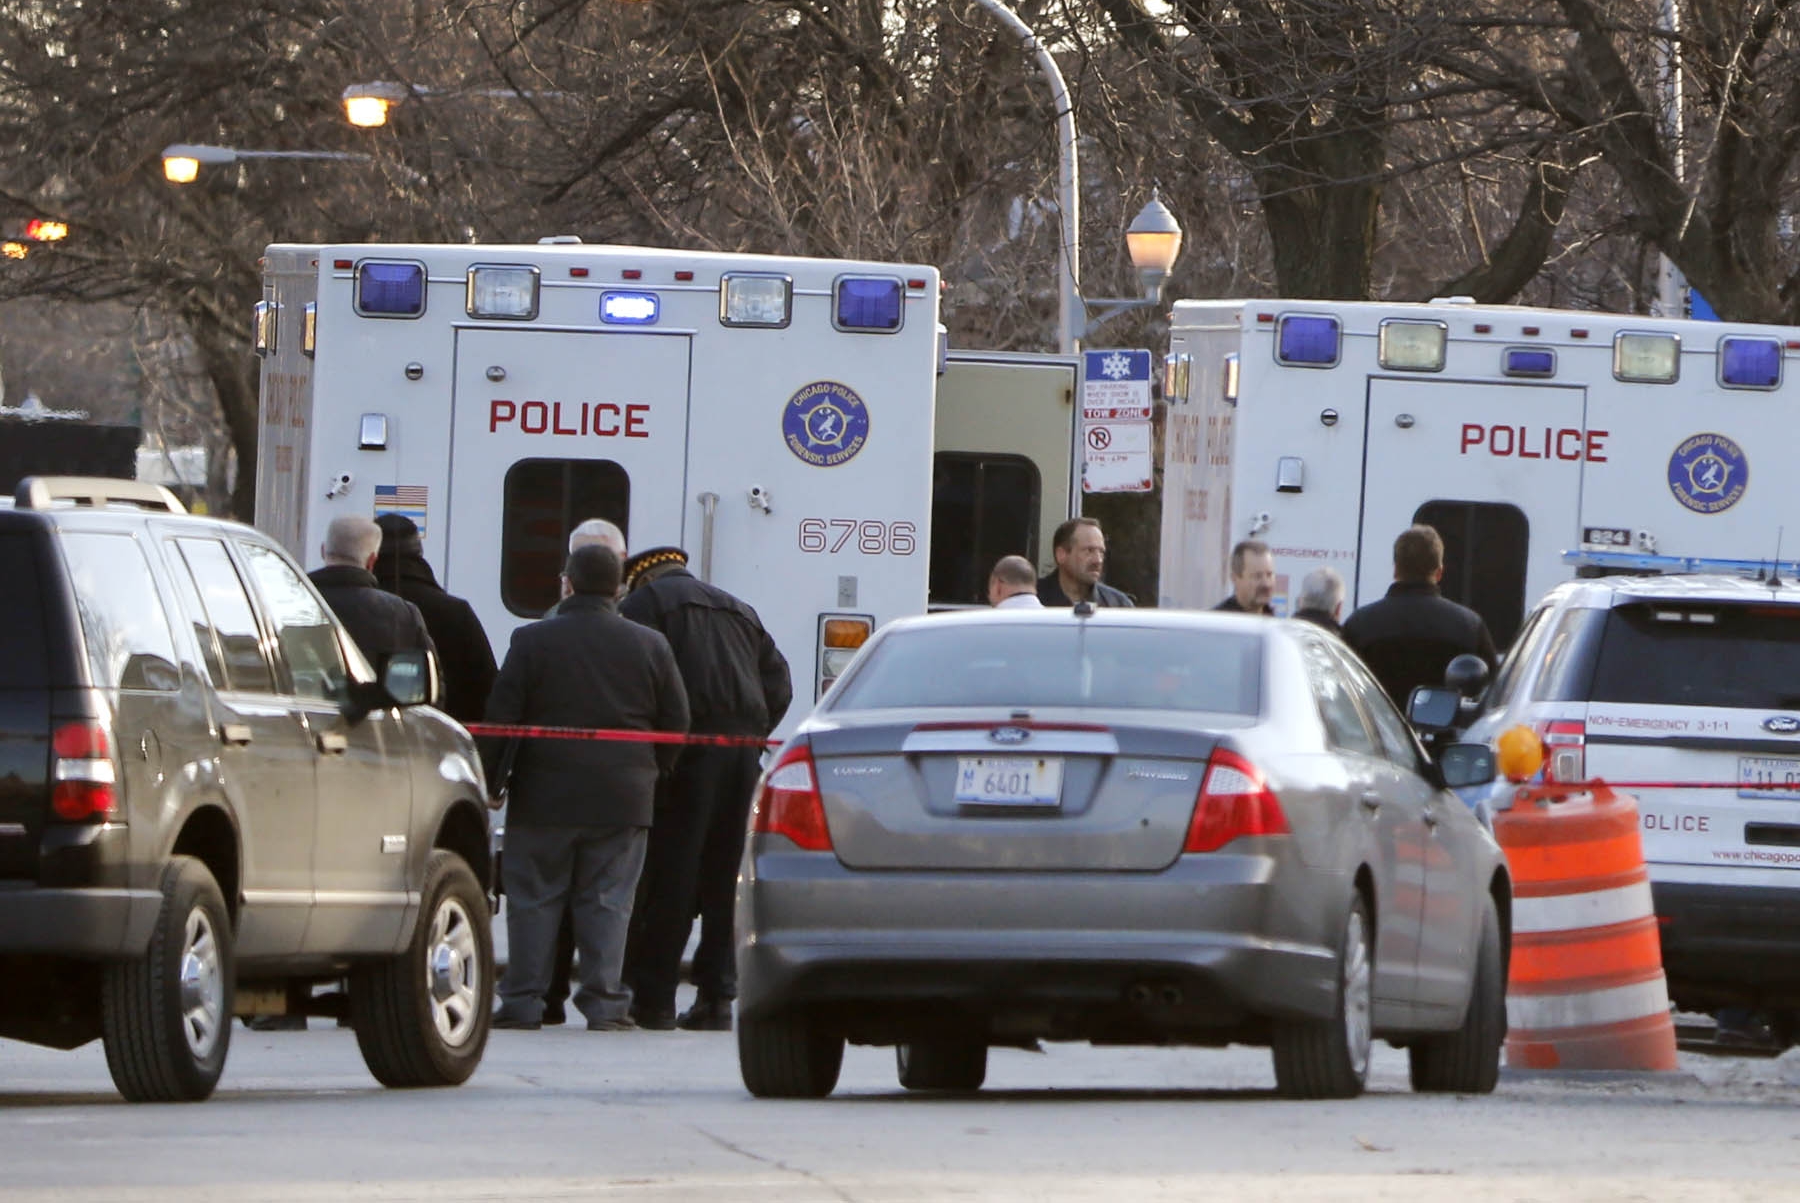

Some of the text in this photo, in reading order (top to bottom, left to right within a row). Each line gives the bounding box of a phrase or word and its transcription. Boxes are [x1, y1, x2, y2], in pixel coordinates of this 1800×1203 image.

[793, 384, 860, 408] CHICAGO POLICE
[489, 400, 649, 437] POLICE
[1086, 407, 1143, 418] TOW ZONE
[826, 435, 863, 464] SERVICES
[1461, 423, 1609, 462] POLICE
[799, 518, 916, 555] 6786
[1271, 548, 1329, 559] MERGENCY
[1589, 715, 1729, 732] NON-EMERGENCY 3-1-1
[984, 772, 1031, 795] 6401
[1640, 813, 1710, 832] OLICE
